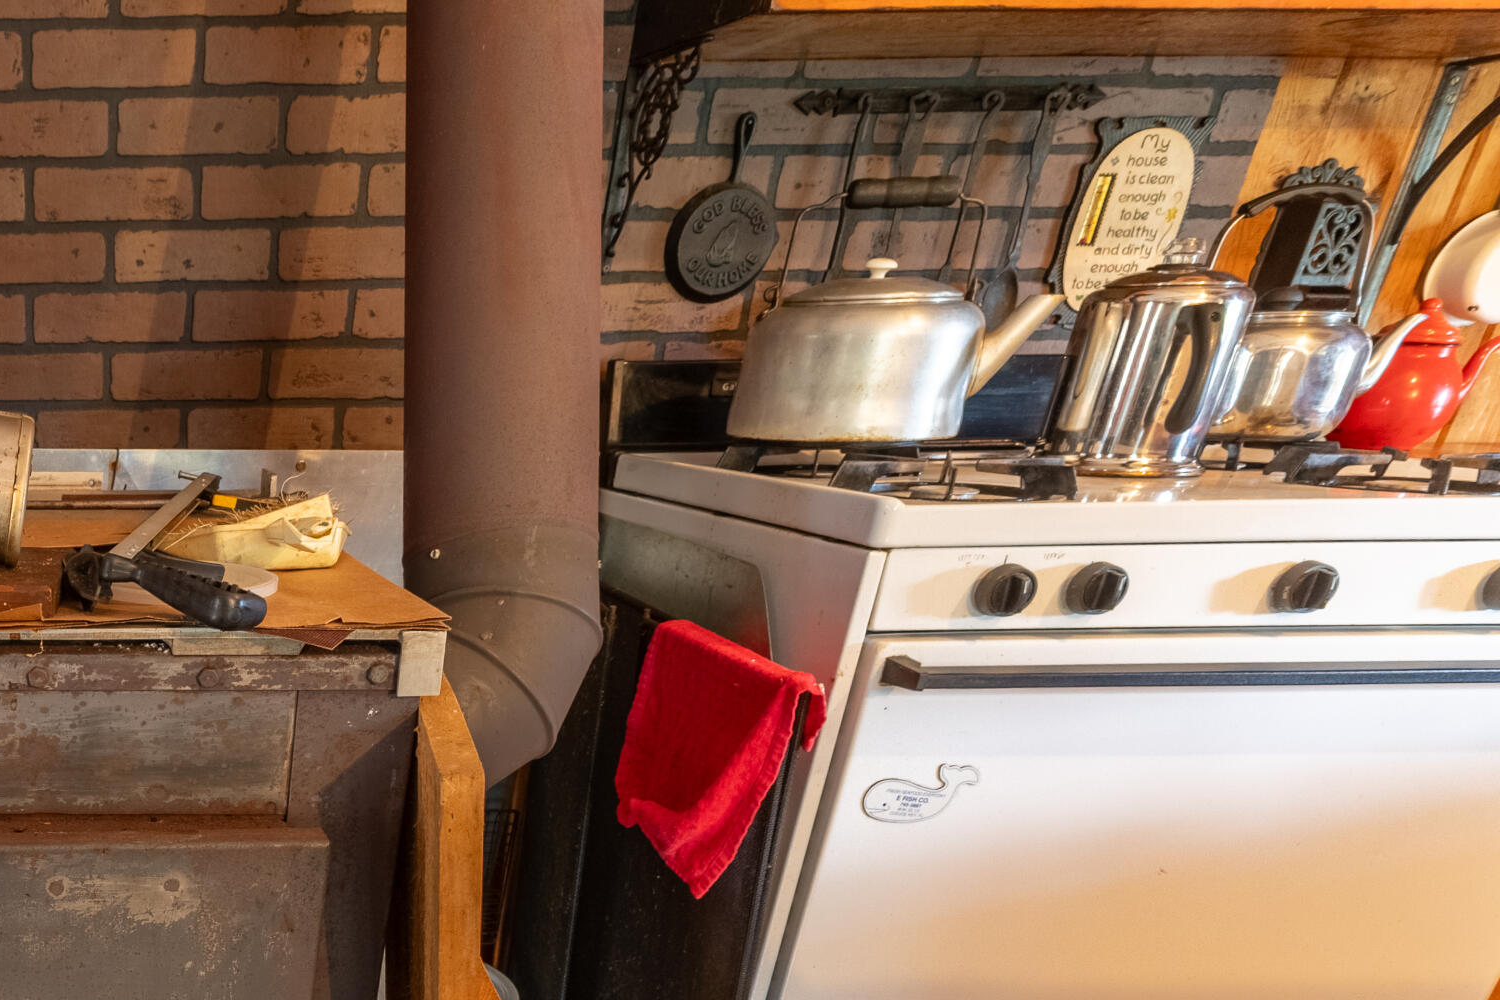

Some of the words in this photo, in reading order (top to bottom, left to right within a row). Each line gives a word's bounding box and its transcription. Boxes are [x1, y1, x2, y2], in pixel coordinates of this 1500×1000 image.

[1141, 134, 1171, 153] My
[1126, 155, 1168, 167] house
[1125, 171, 1136, 185] is
[1139, 173, 1174, 185] clean
[1119, 190, 1166, 205] enough
[693, 200, 724, 233] GOD
[731, 196, 768, 235] BLESS
[1120, 208, 1131, 220] to
[1133, 208, 1149, 220] be
[1106, 226, 1158, 241] healthy
[1094, 242, 1119, 255] and
[1122, 242, 1152, 259] dirty
[686, 257, 714, 287] OUR
[715, 252, 757, 288] HOME
[1090, 261, 1138, 275] enough
[1072, 278, 1083, 289] to
[1085, 278, 1101, 289] be
